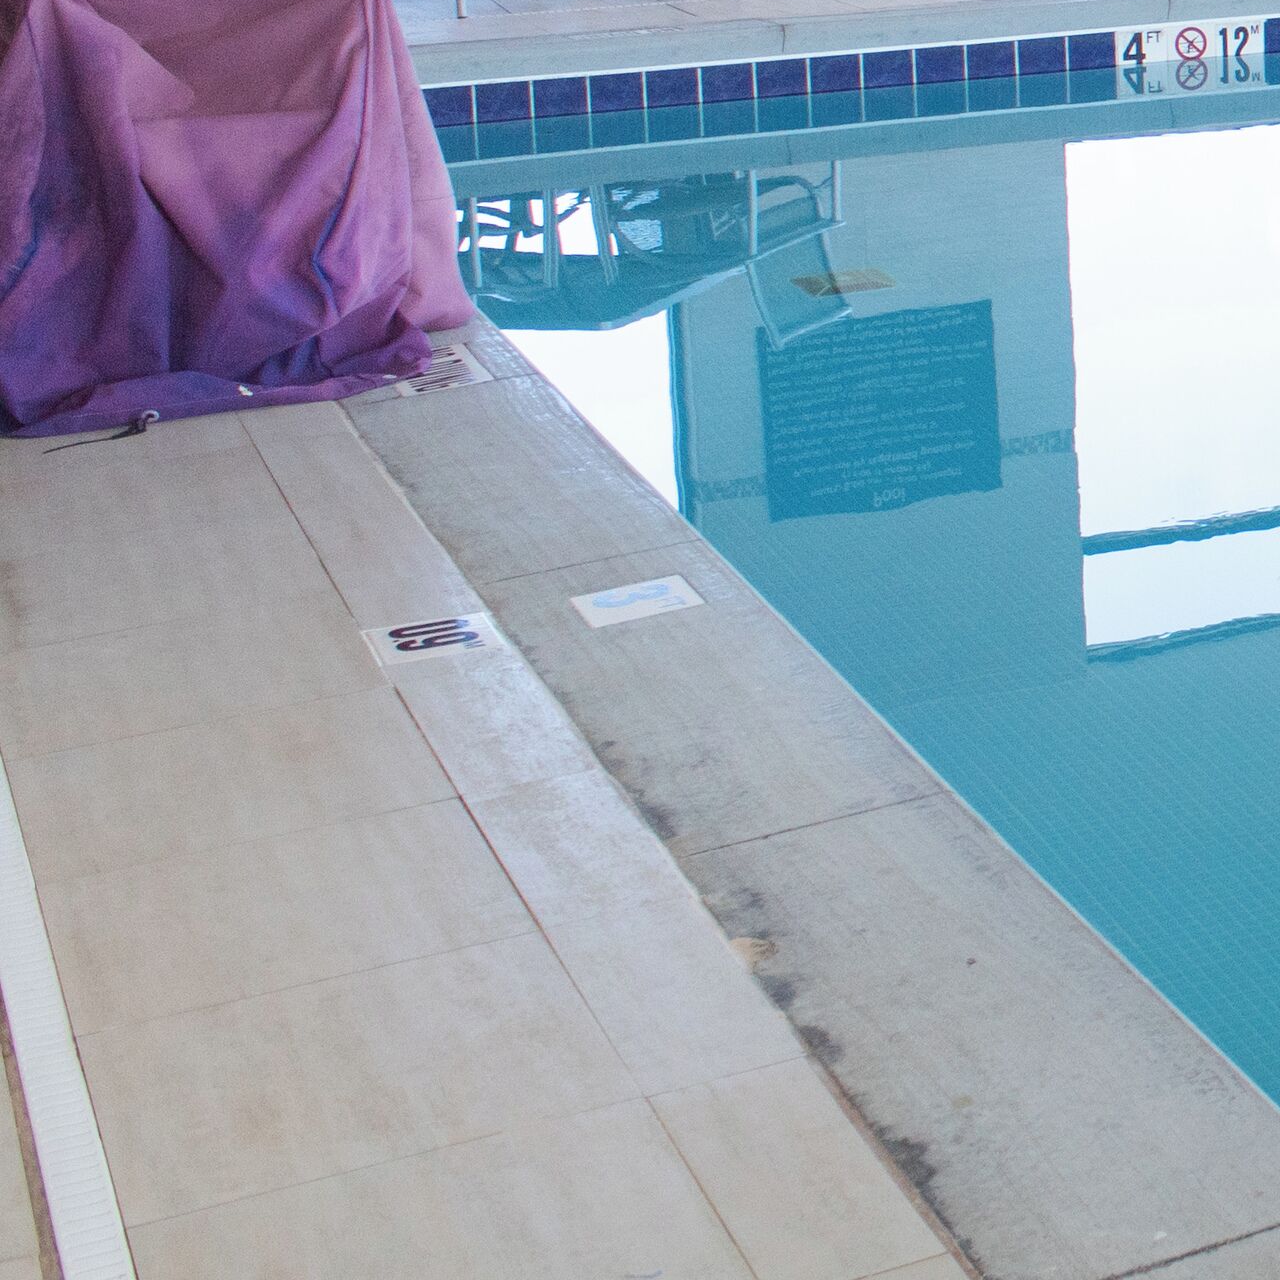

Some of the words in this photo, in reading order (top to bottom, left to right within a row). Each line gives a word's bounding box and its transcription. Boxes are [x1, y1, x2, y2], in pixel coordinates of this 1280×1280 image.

[1123, 32, 1146, 64] 4
[1147, 30, 1161, 43] FT
[1251, 25, 1260, 34] M
[592, 583, 671, 609] 3
